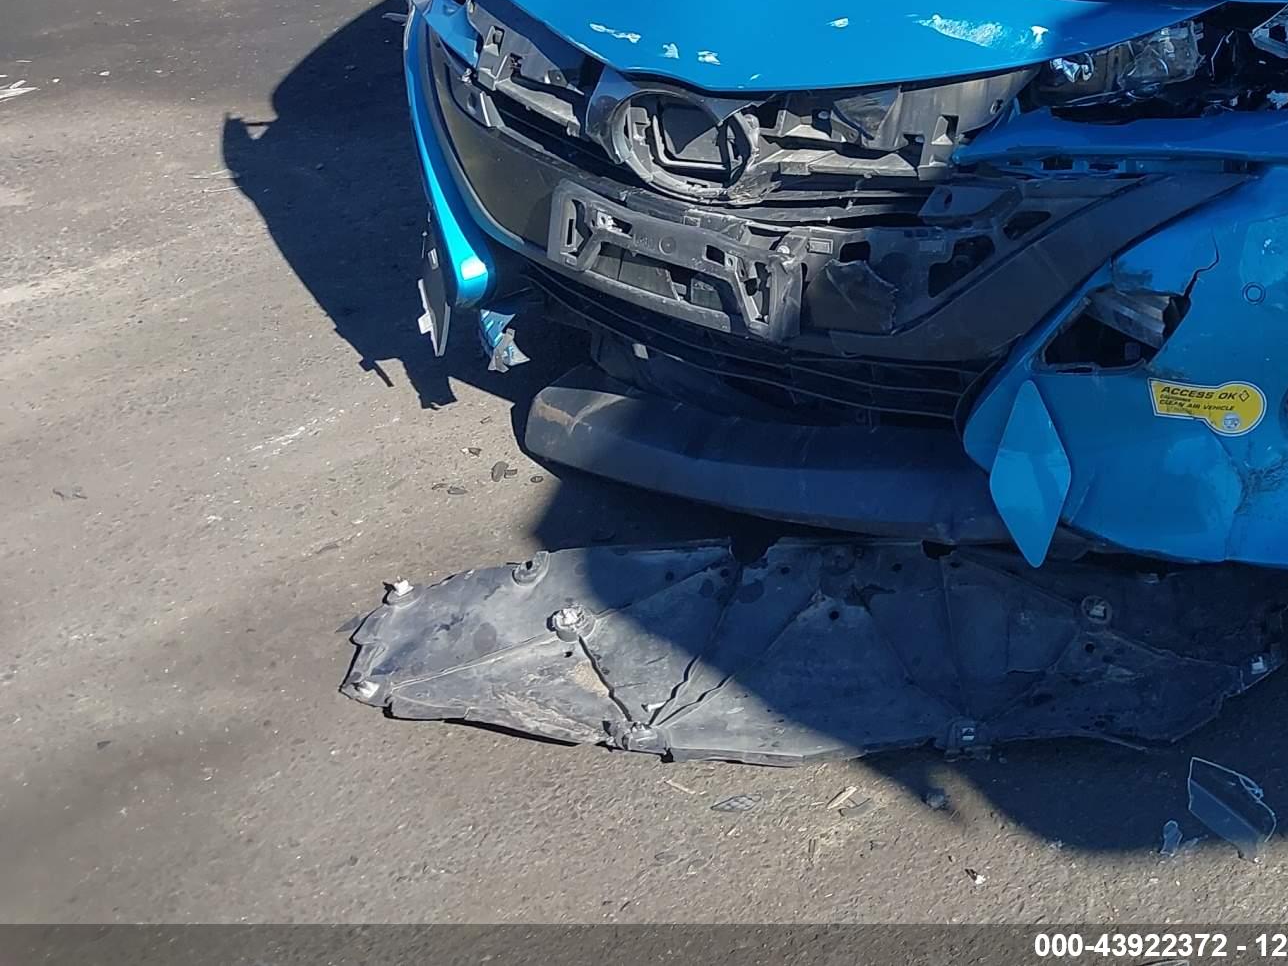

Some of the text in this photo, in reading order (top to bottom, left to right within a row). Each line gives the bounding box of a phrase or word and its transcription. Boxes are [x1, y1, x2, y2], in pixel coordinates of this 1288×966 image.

[1160, 386, 1214, 400] ACCESS
[1218, 391, 1238, 400] OK
[1160, 399, 1185, 408] CLEAN
